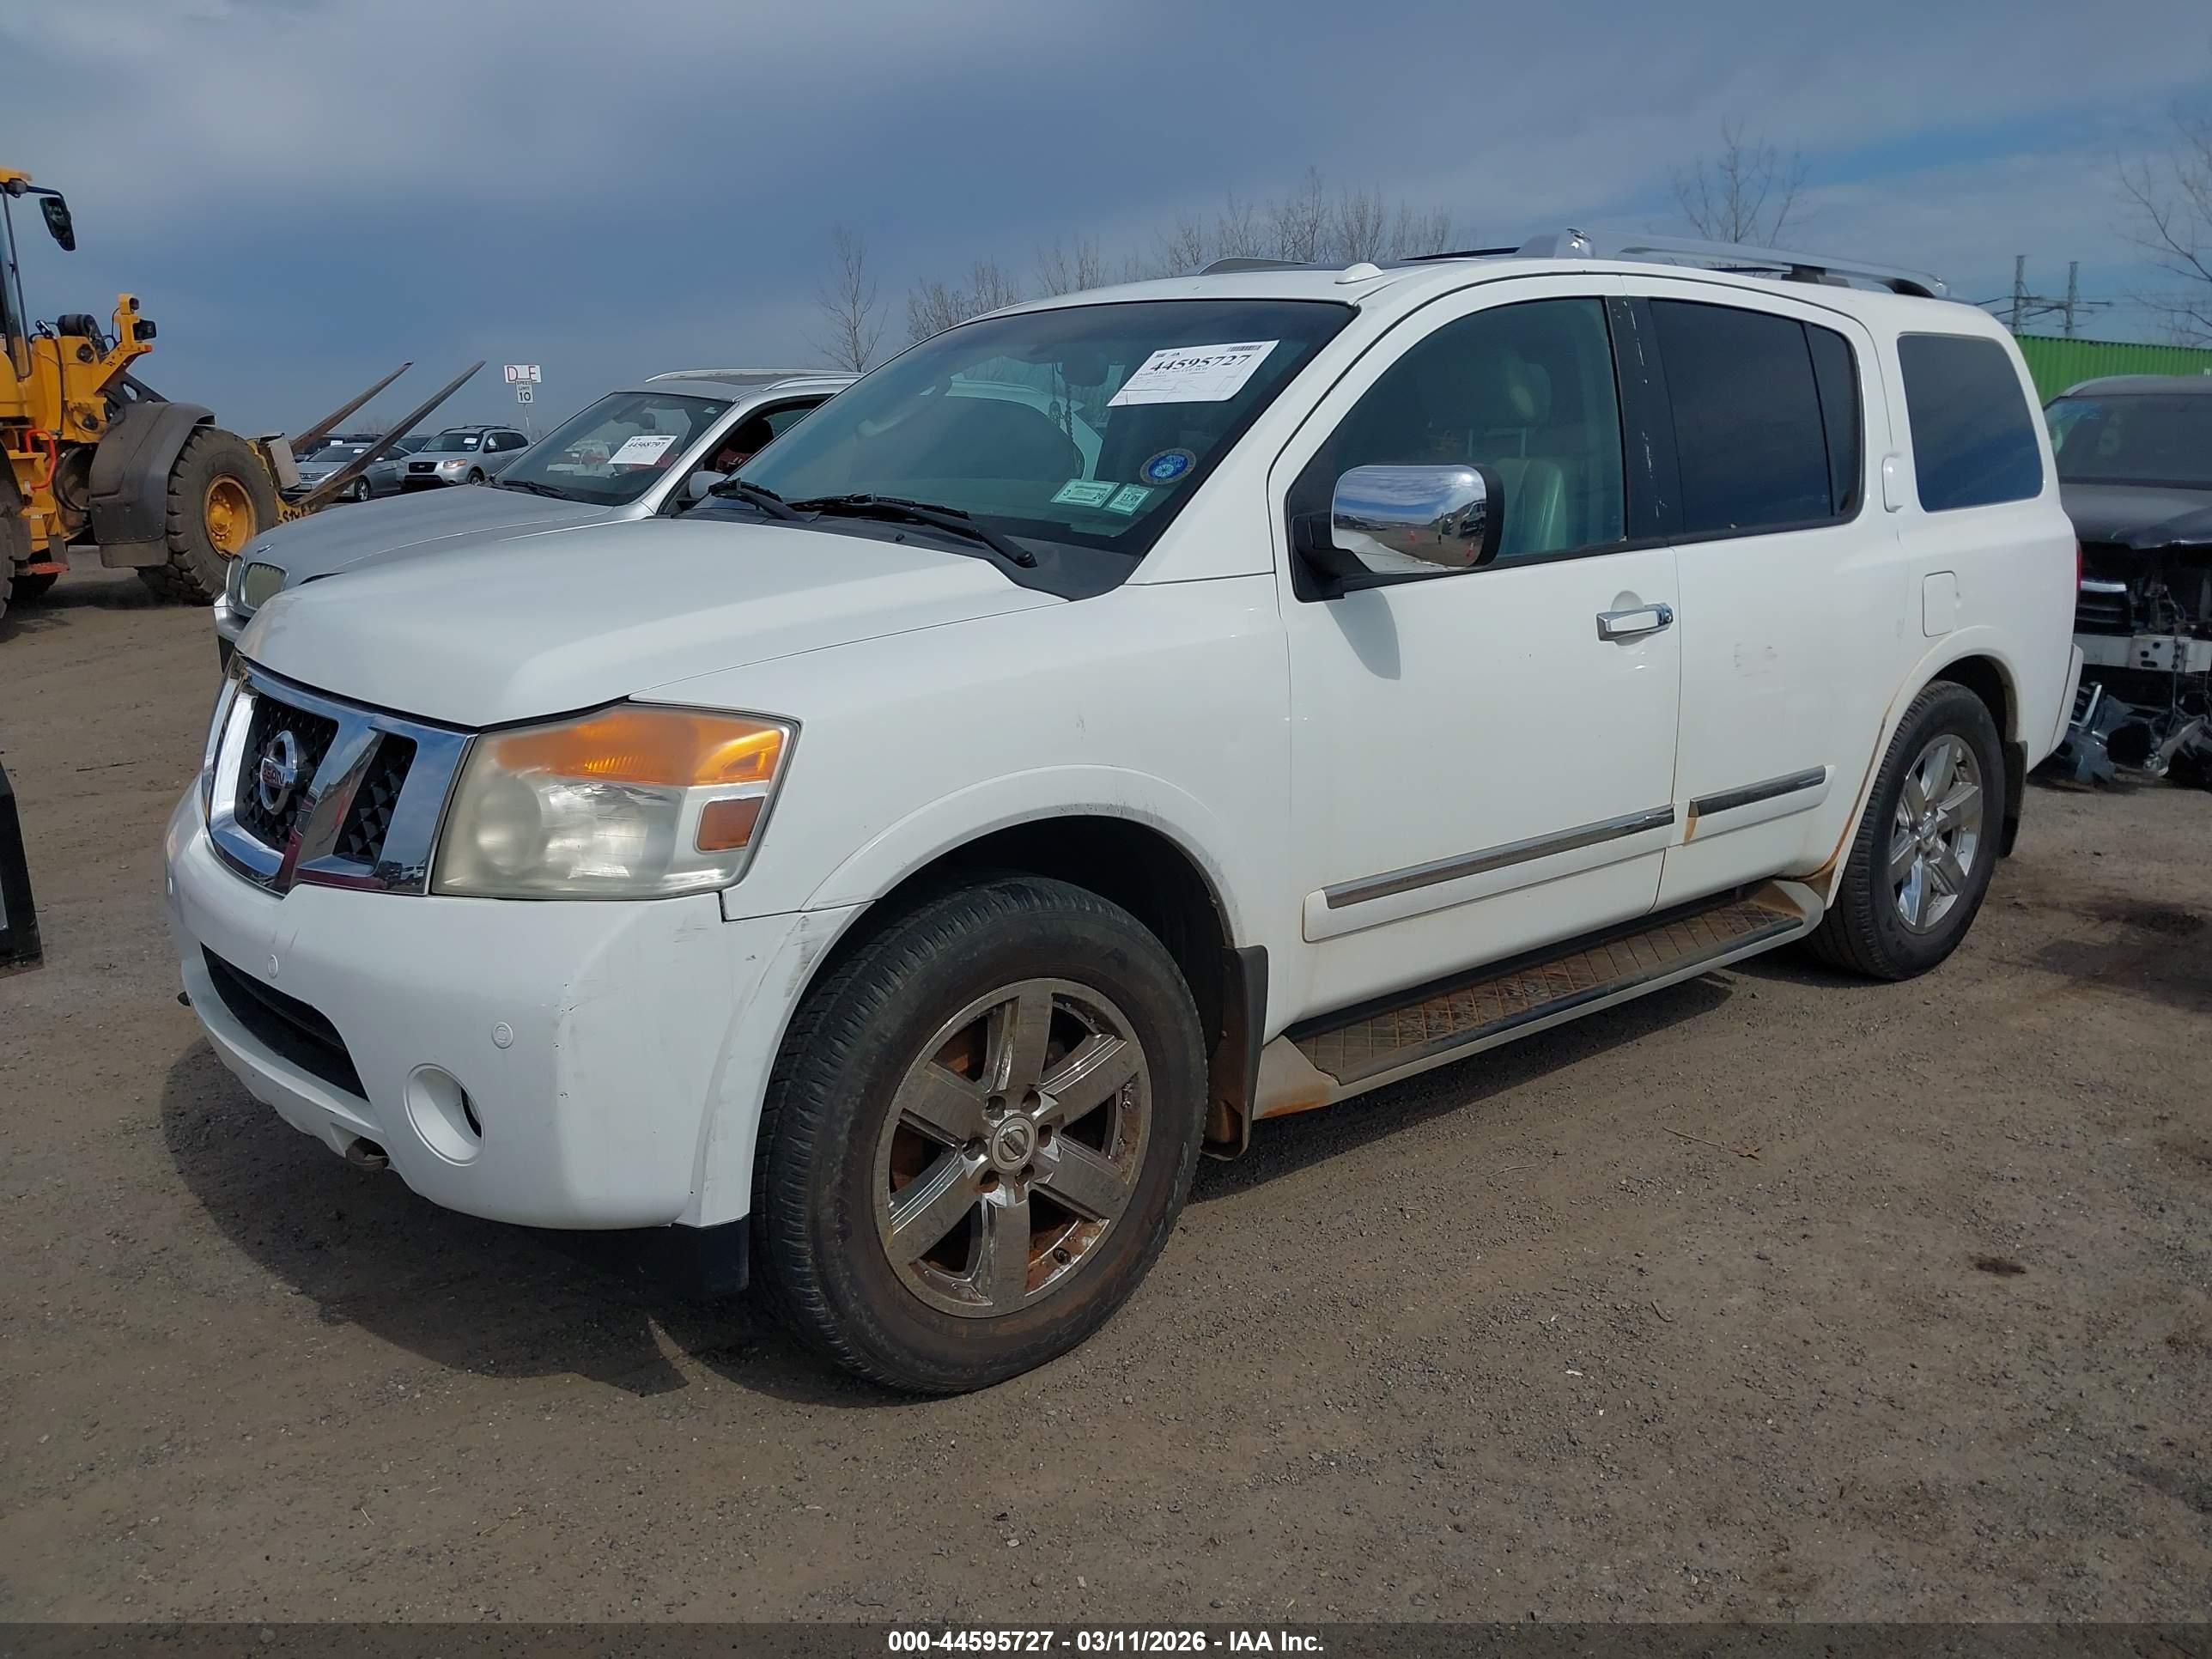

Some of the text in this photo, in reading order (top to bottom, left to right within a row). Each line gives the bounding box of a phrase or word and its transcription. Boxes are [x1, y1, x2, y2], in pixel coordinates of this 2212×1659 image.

[1149, 354, 1252, 371] 44595727
[507, 366, 518, 381] D
[519, 392, 532, 402] 10
